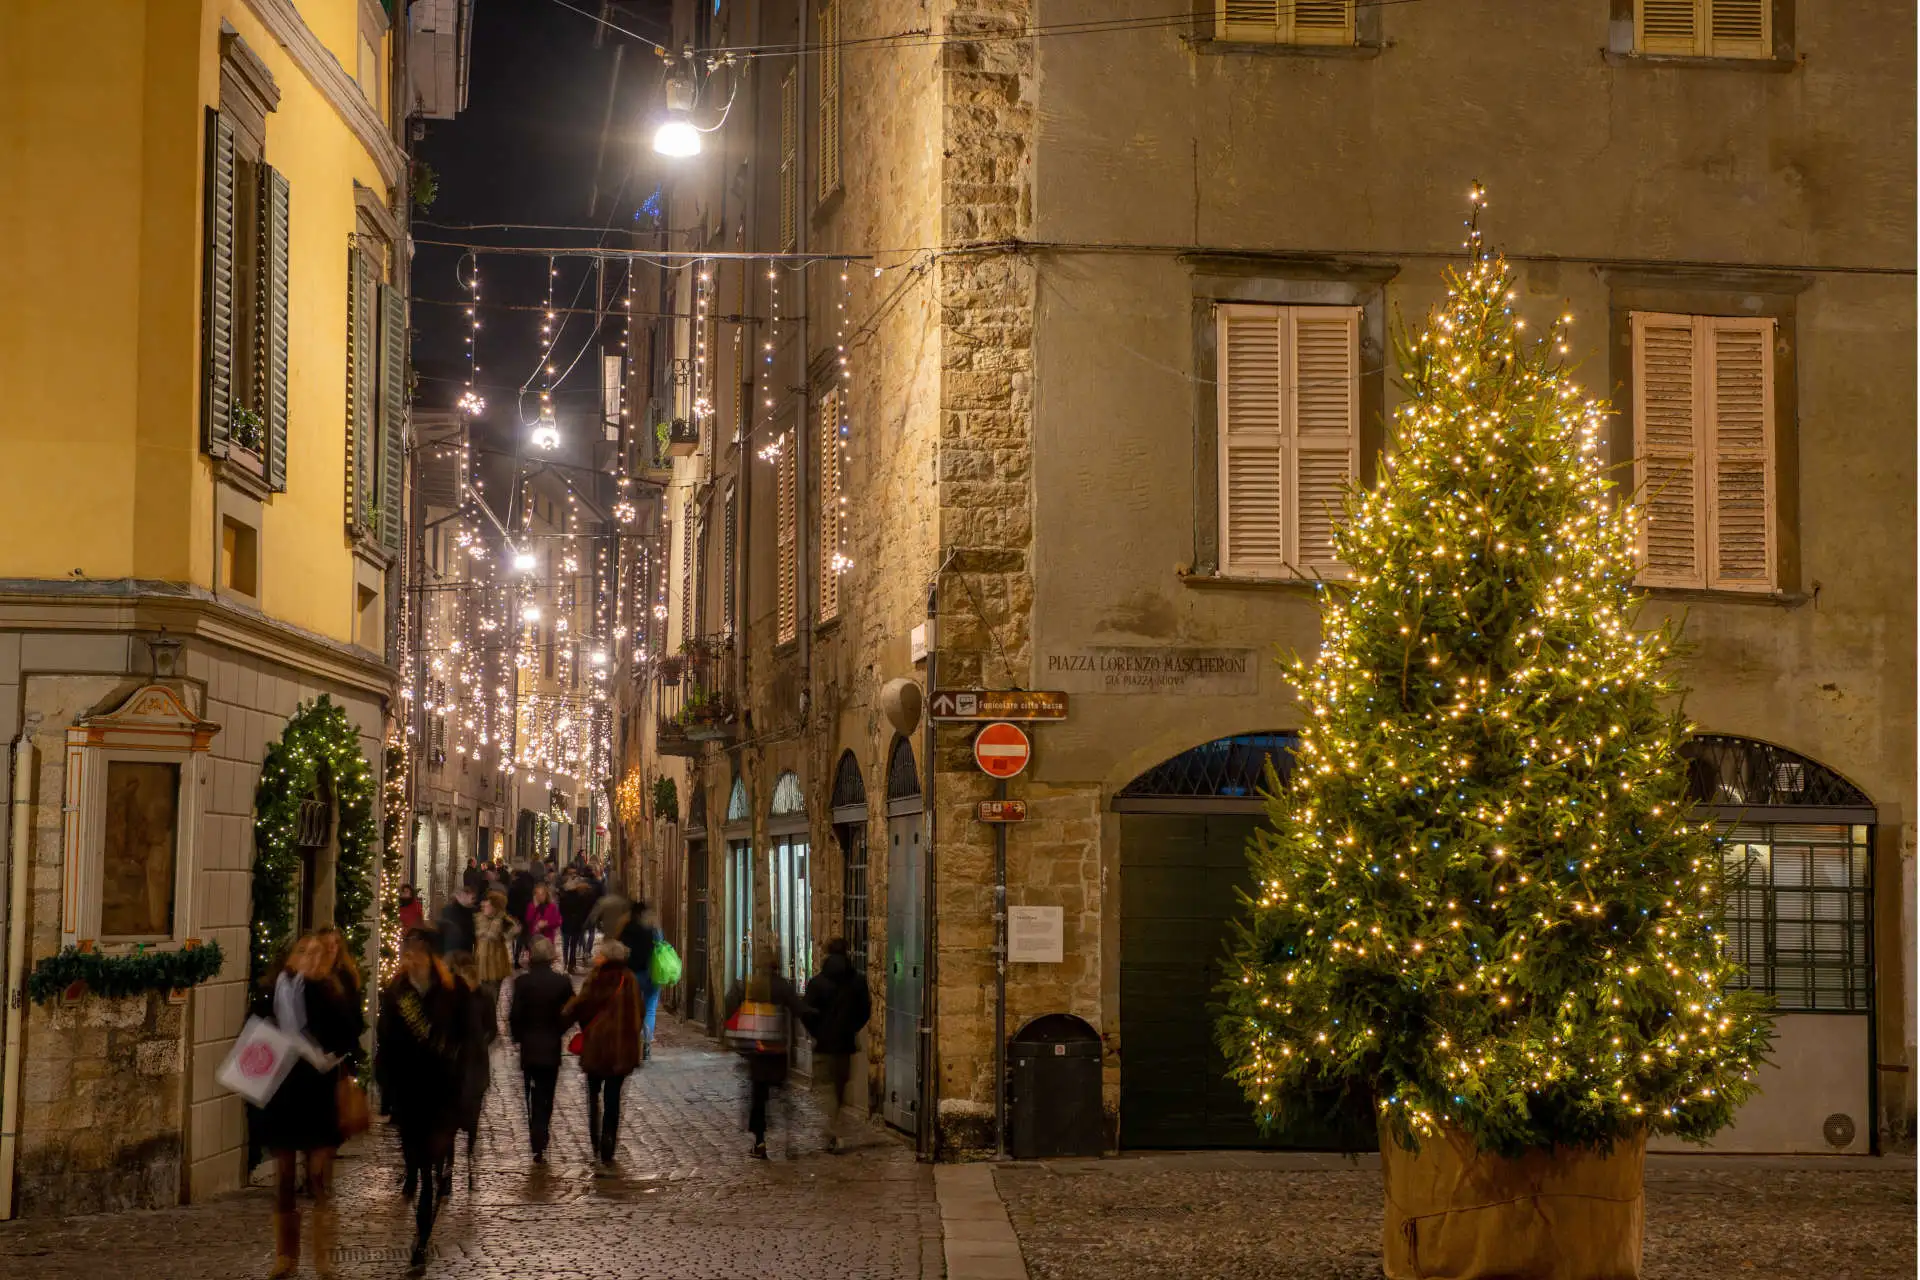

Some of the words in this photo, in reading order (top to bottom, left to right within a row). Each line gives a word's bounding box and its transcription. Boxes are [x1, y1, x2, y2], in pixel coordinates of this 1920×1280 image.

[1048, 655, 1096, 671] PIAZZA
[1100, 656, 1160, 672] LORENZO
[1163, 656, 1246, 673] MASCHERONI
[1123, 675, 1154, 686] PIAZZA
